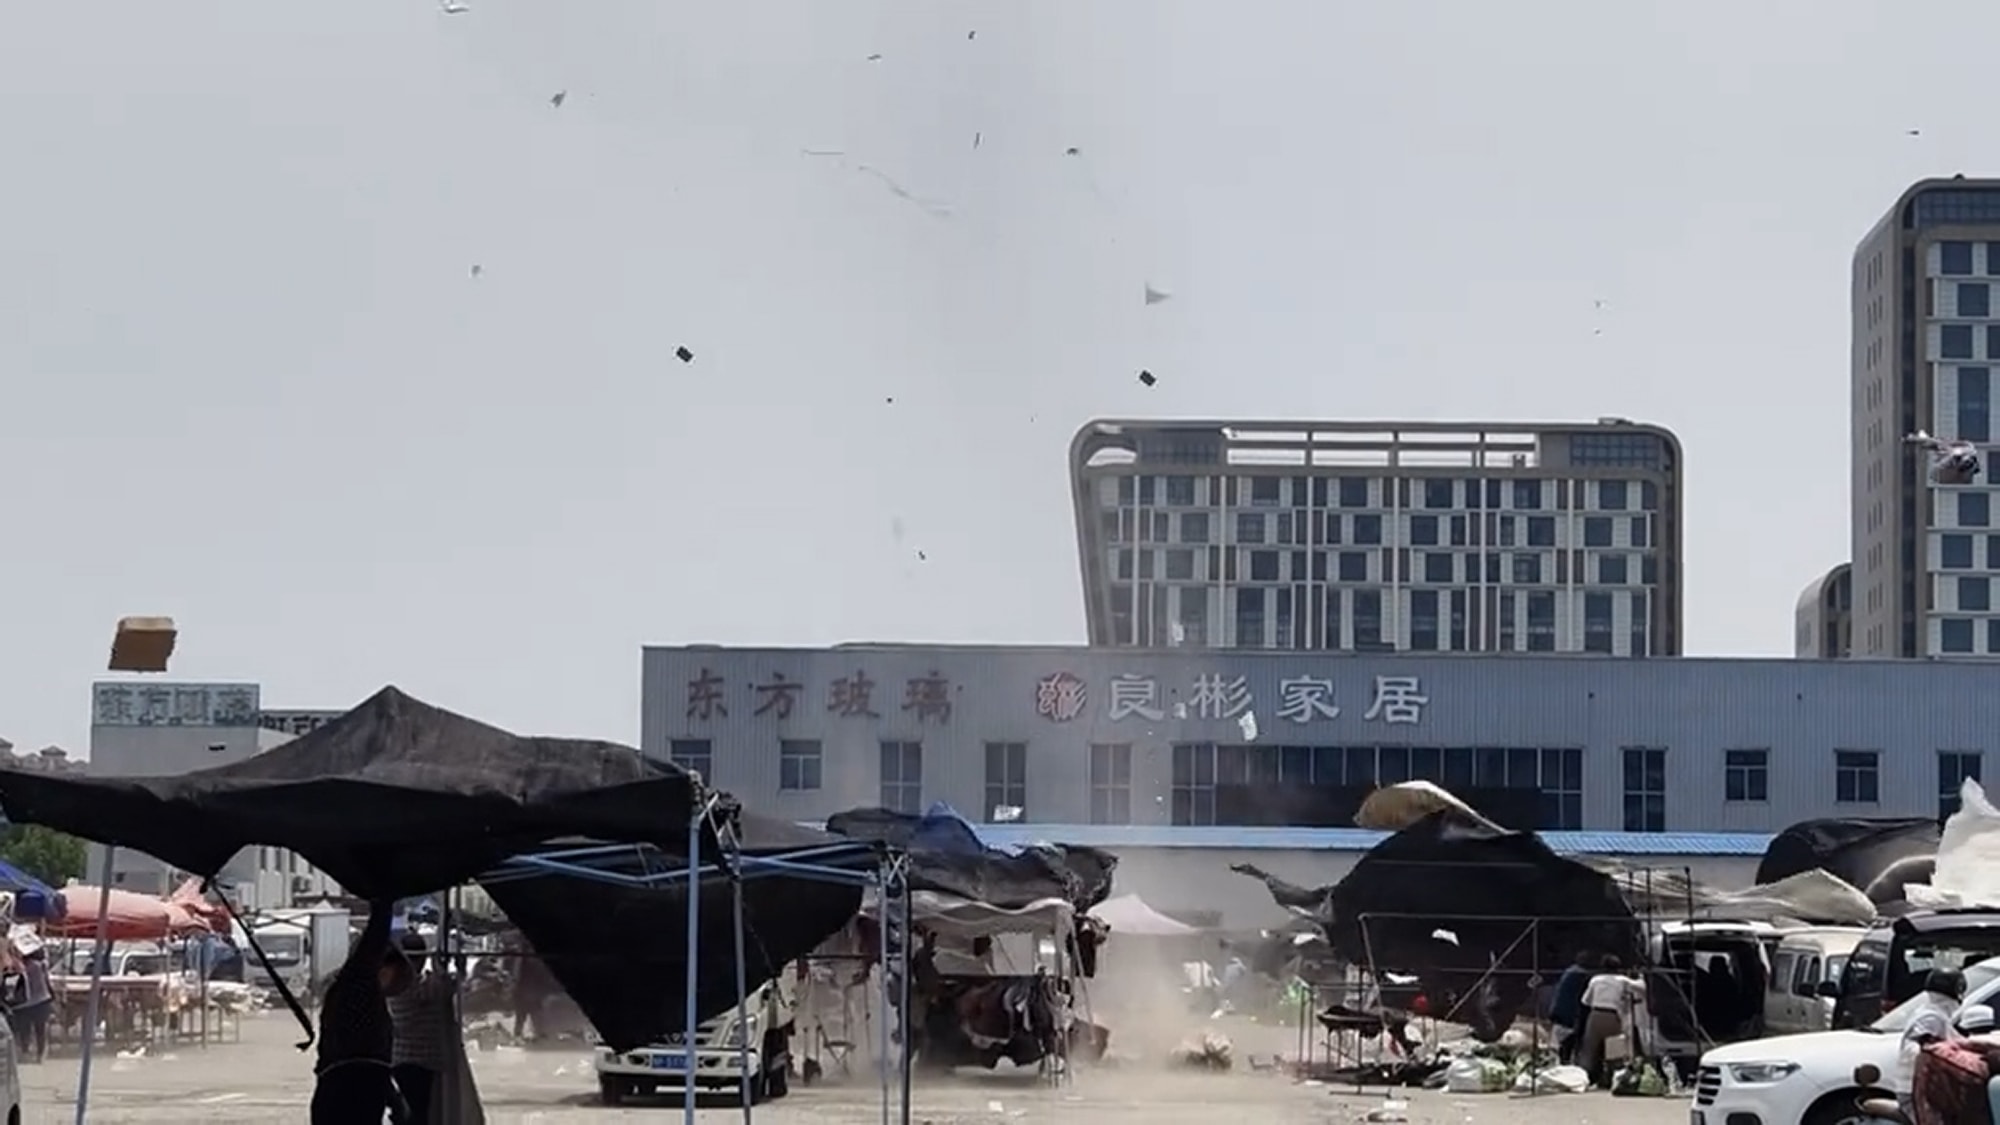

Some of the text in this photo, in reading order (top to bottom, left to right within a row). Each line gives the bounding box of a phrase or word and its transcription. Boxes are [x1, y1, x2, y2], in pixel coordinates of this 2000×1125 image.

[686, 669, 953, 723] 东方玻璃
[1108, 673, 1430, 724] 良彬家居
